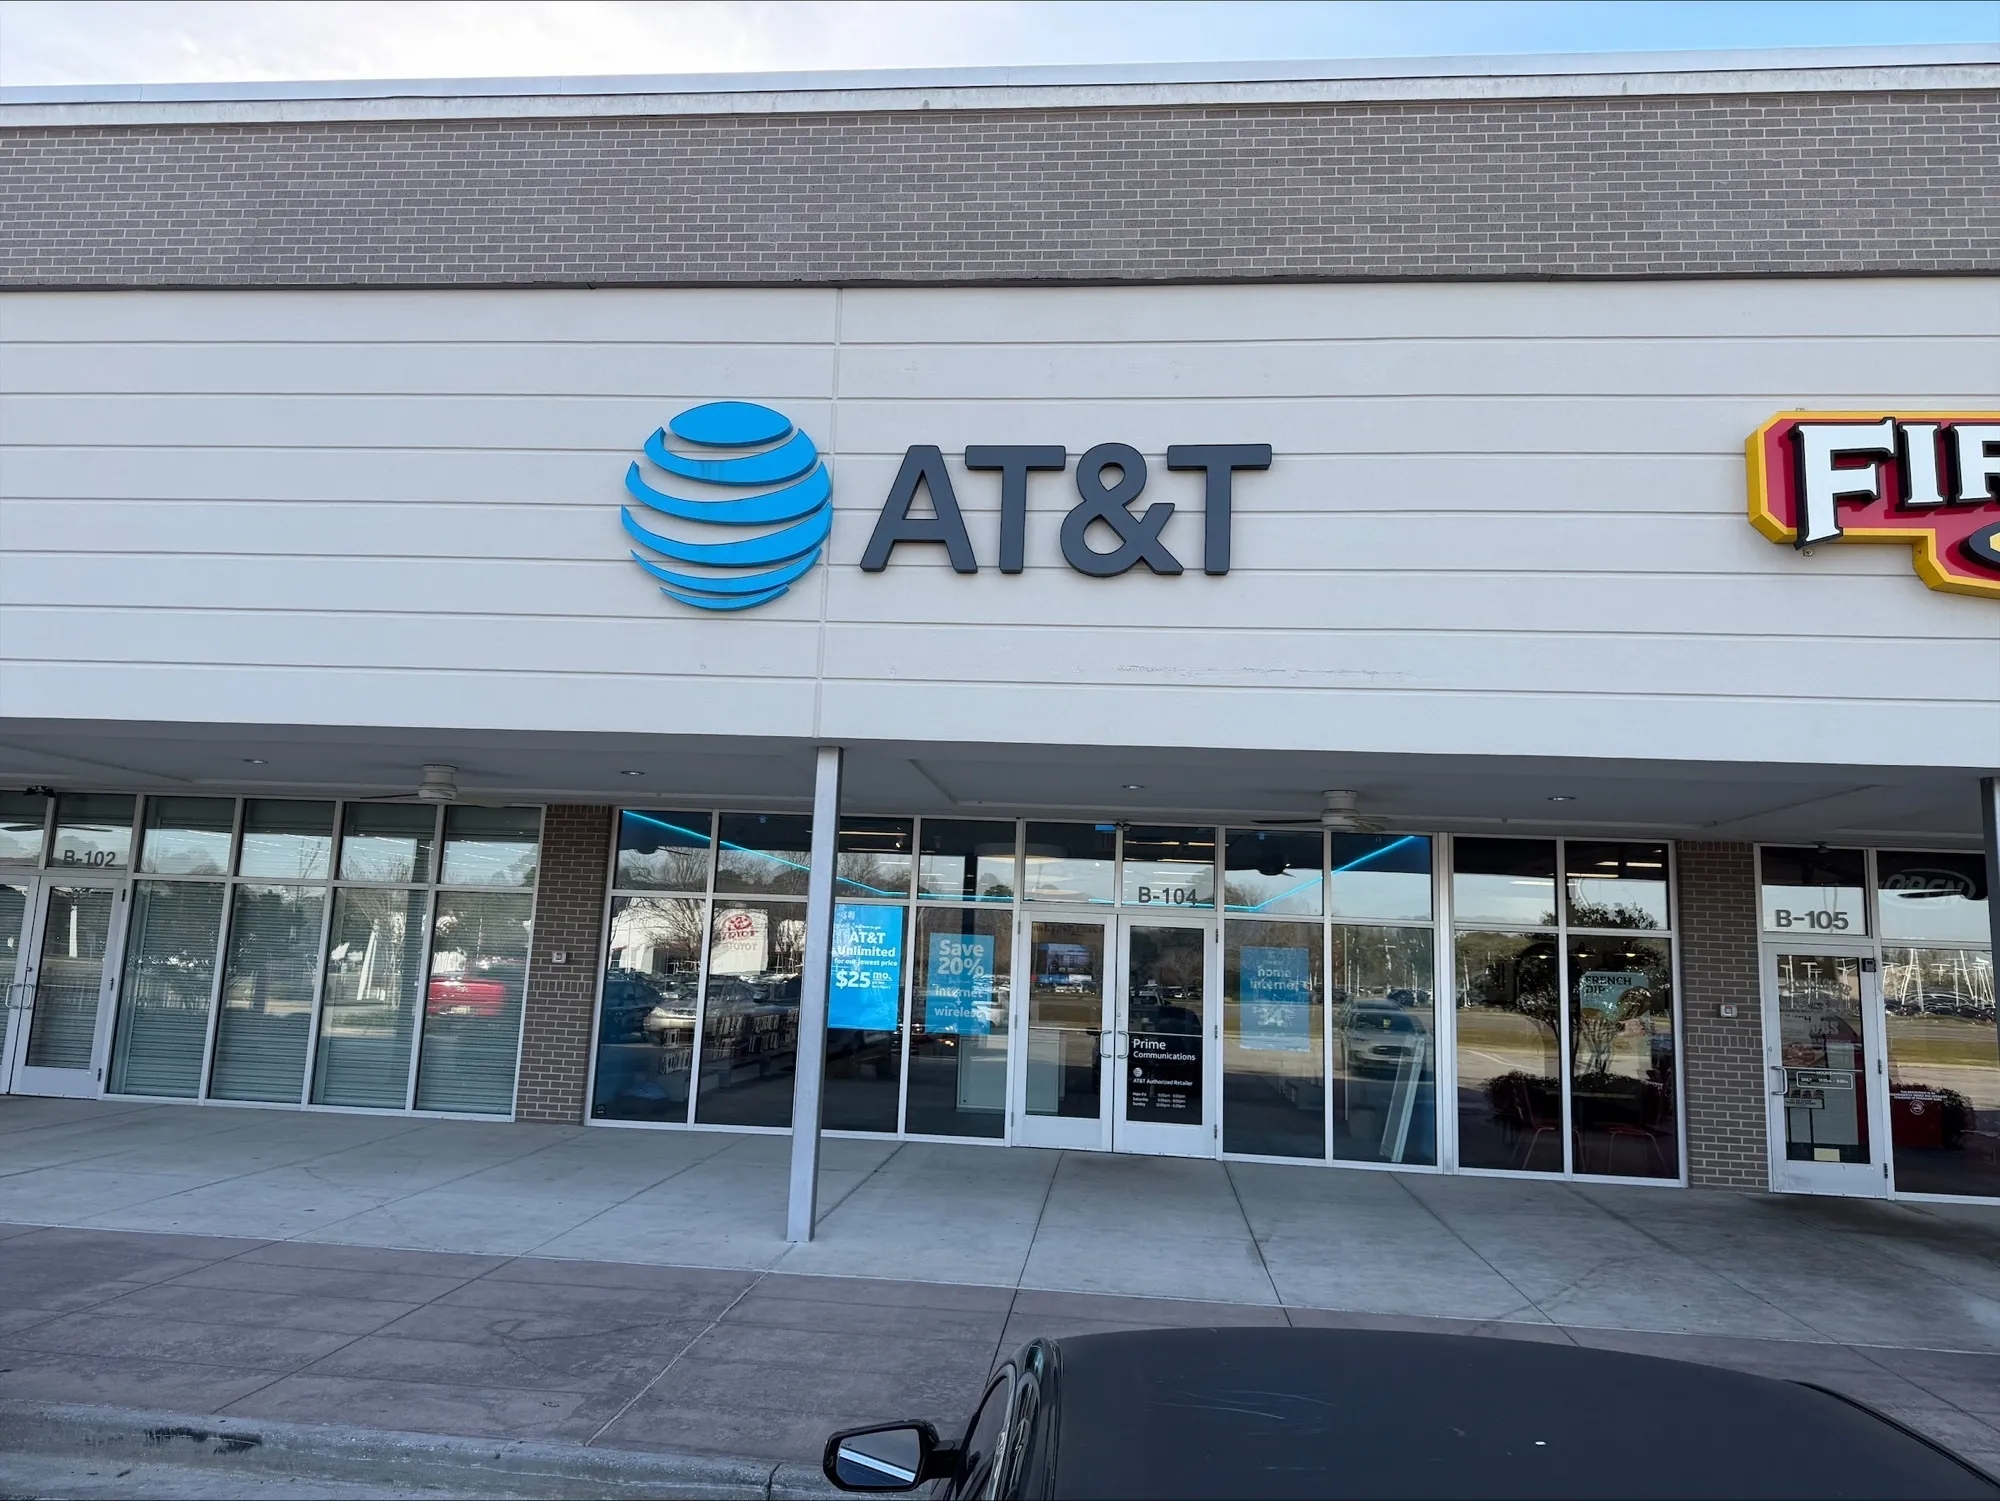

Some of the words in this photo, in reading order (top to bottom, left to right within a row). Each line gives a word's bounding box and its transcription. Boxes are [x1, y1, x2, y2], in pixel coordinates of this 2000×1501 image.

[859, 441, 1272, 578] AT&T
[63, 849, 116, 868] B-102
[1138, 886, 1198, 906] B-104
[1775, 909, 1849, 930] B-105
[849, 931, 887, 944] AT&T
[836, 945, 896, 958] Unlimited
[939, 939, 985, 957] Save
[857, 958, 880, 966] lowest
[881, 959, 898, 967] price
[937, 956, 985, 976] 20%
[1257, 966, 1292, 978] home
[835, 968, 871, 990] $25
[872, 971, 892, 980] mo.
[1584, 975, 1632, 986] FRENCH
[1585, 985, 1606, 994] DIP
[1132, 1038, 1167, 1050] Prime
[1132, 1050, 1196, 1061] Communications
[1146, 1078, 1173, 1086] Authorized
